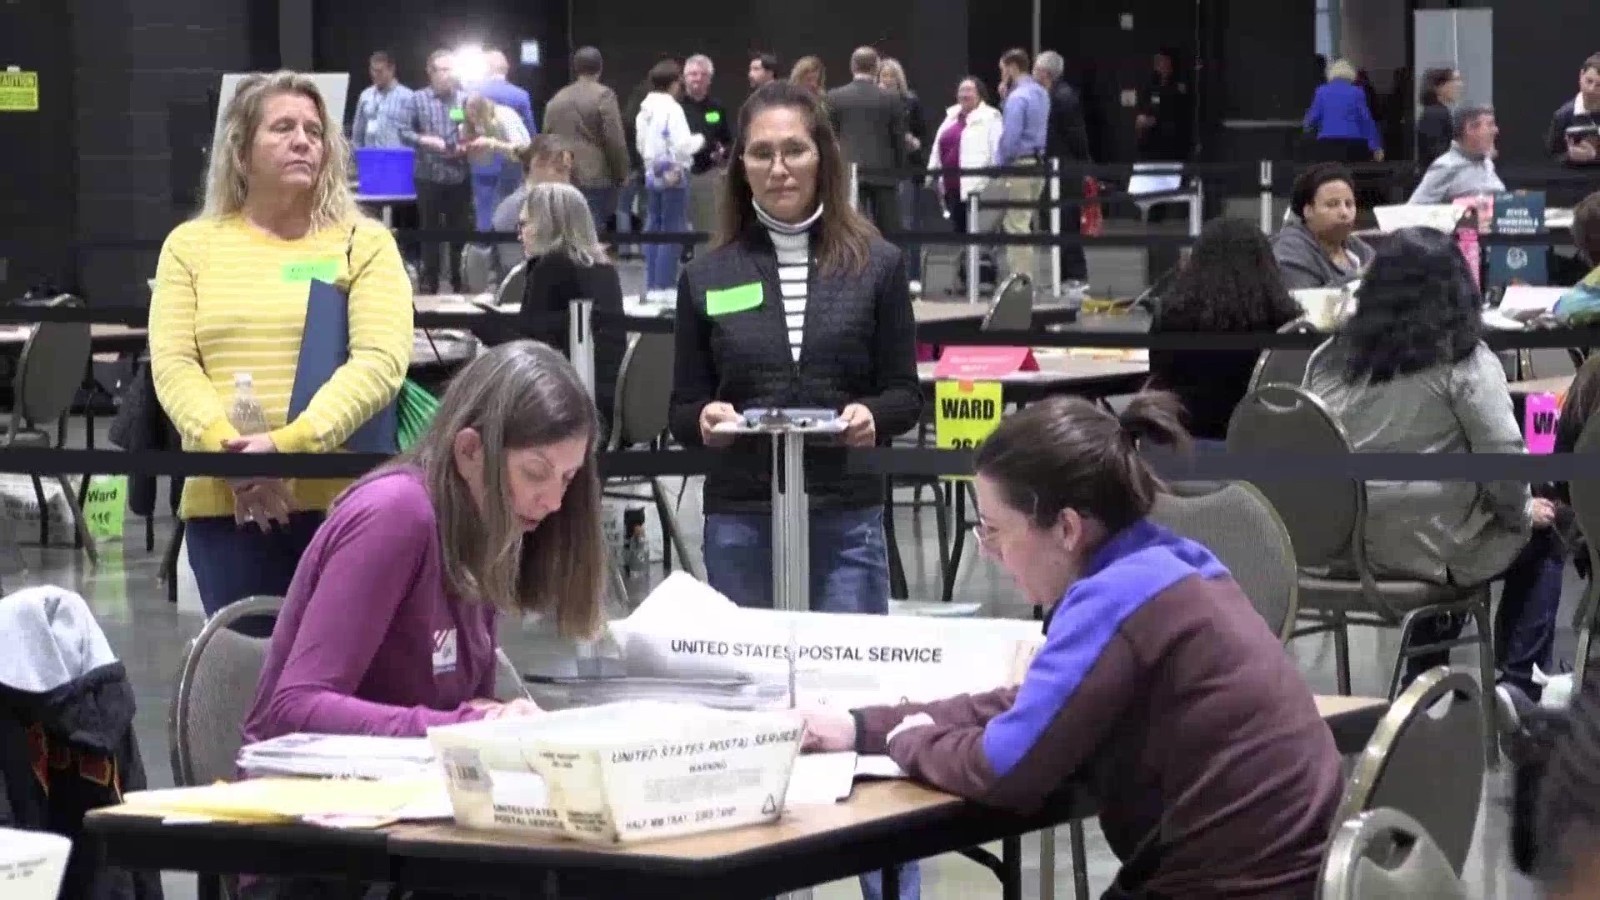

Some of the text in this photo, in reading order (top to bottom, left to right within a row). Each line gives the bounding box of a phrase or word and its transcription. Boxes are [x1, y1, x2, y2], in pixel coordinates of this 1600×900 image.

[942, 398, 995, 420] WARD
[88, 488, 117, 502] Ward
[671, 639, 943, 663] UNITED STATES POSTAL SERVICE
[612, 728, 800, 763] UNITED STATES POSTAL SERVICE
[493, 804, 559, 818] UNITED STATES
[494, 814, 525, 825] POSTAL
